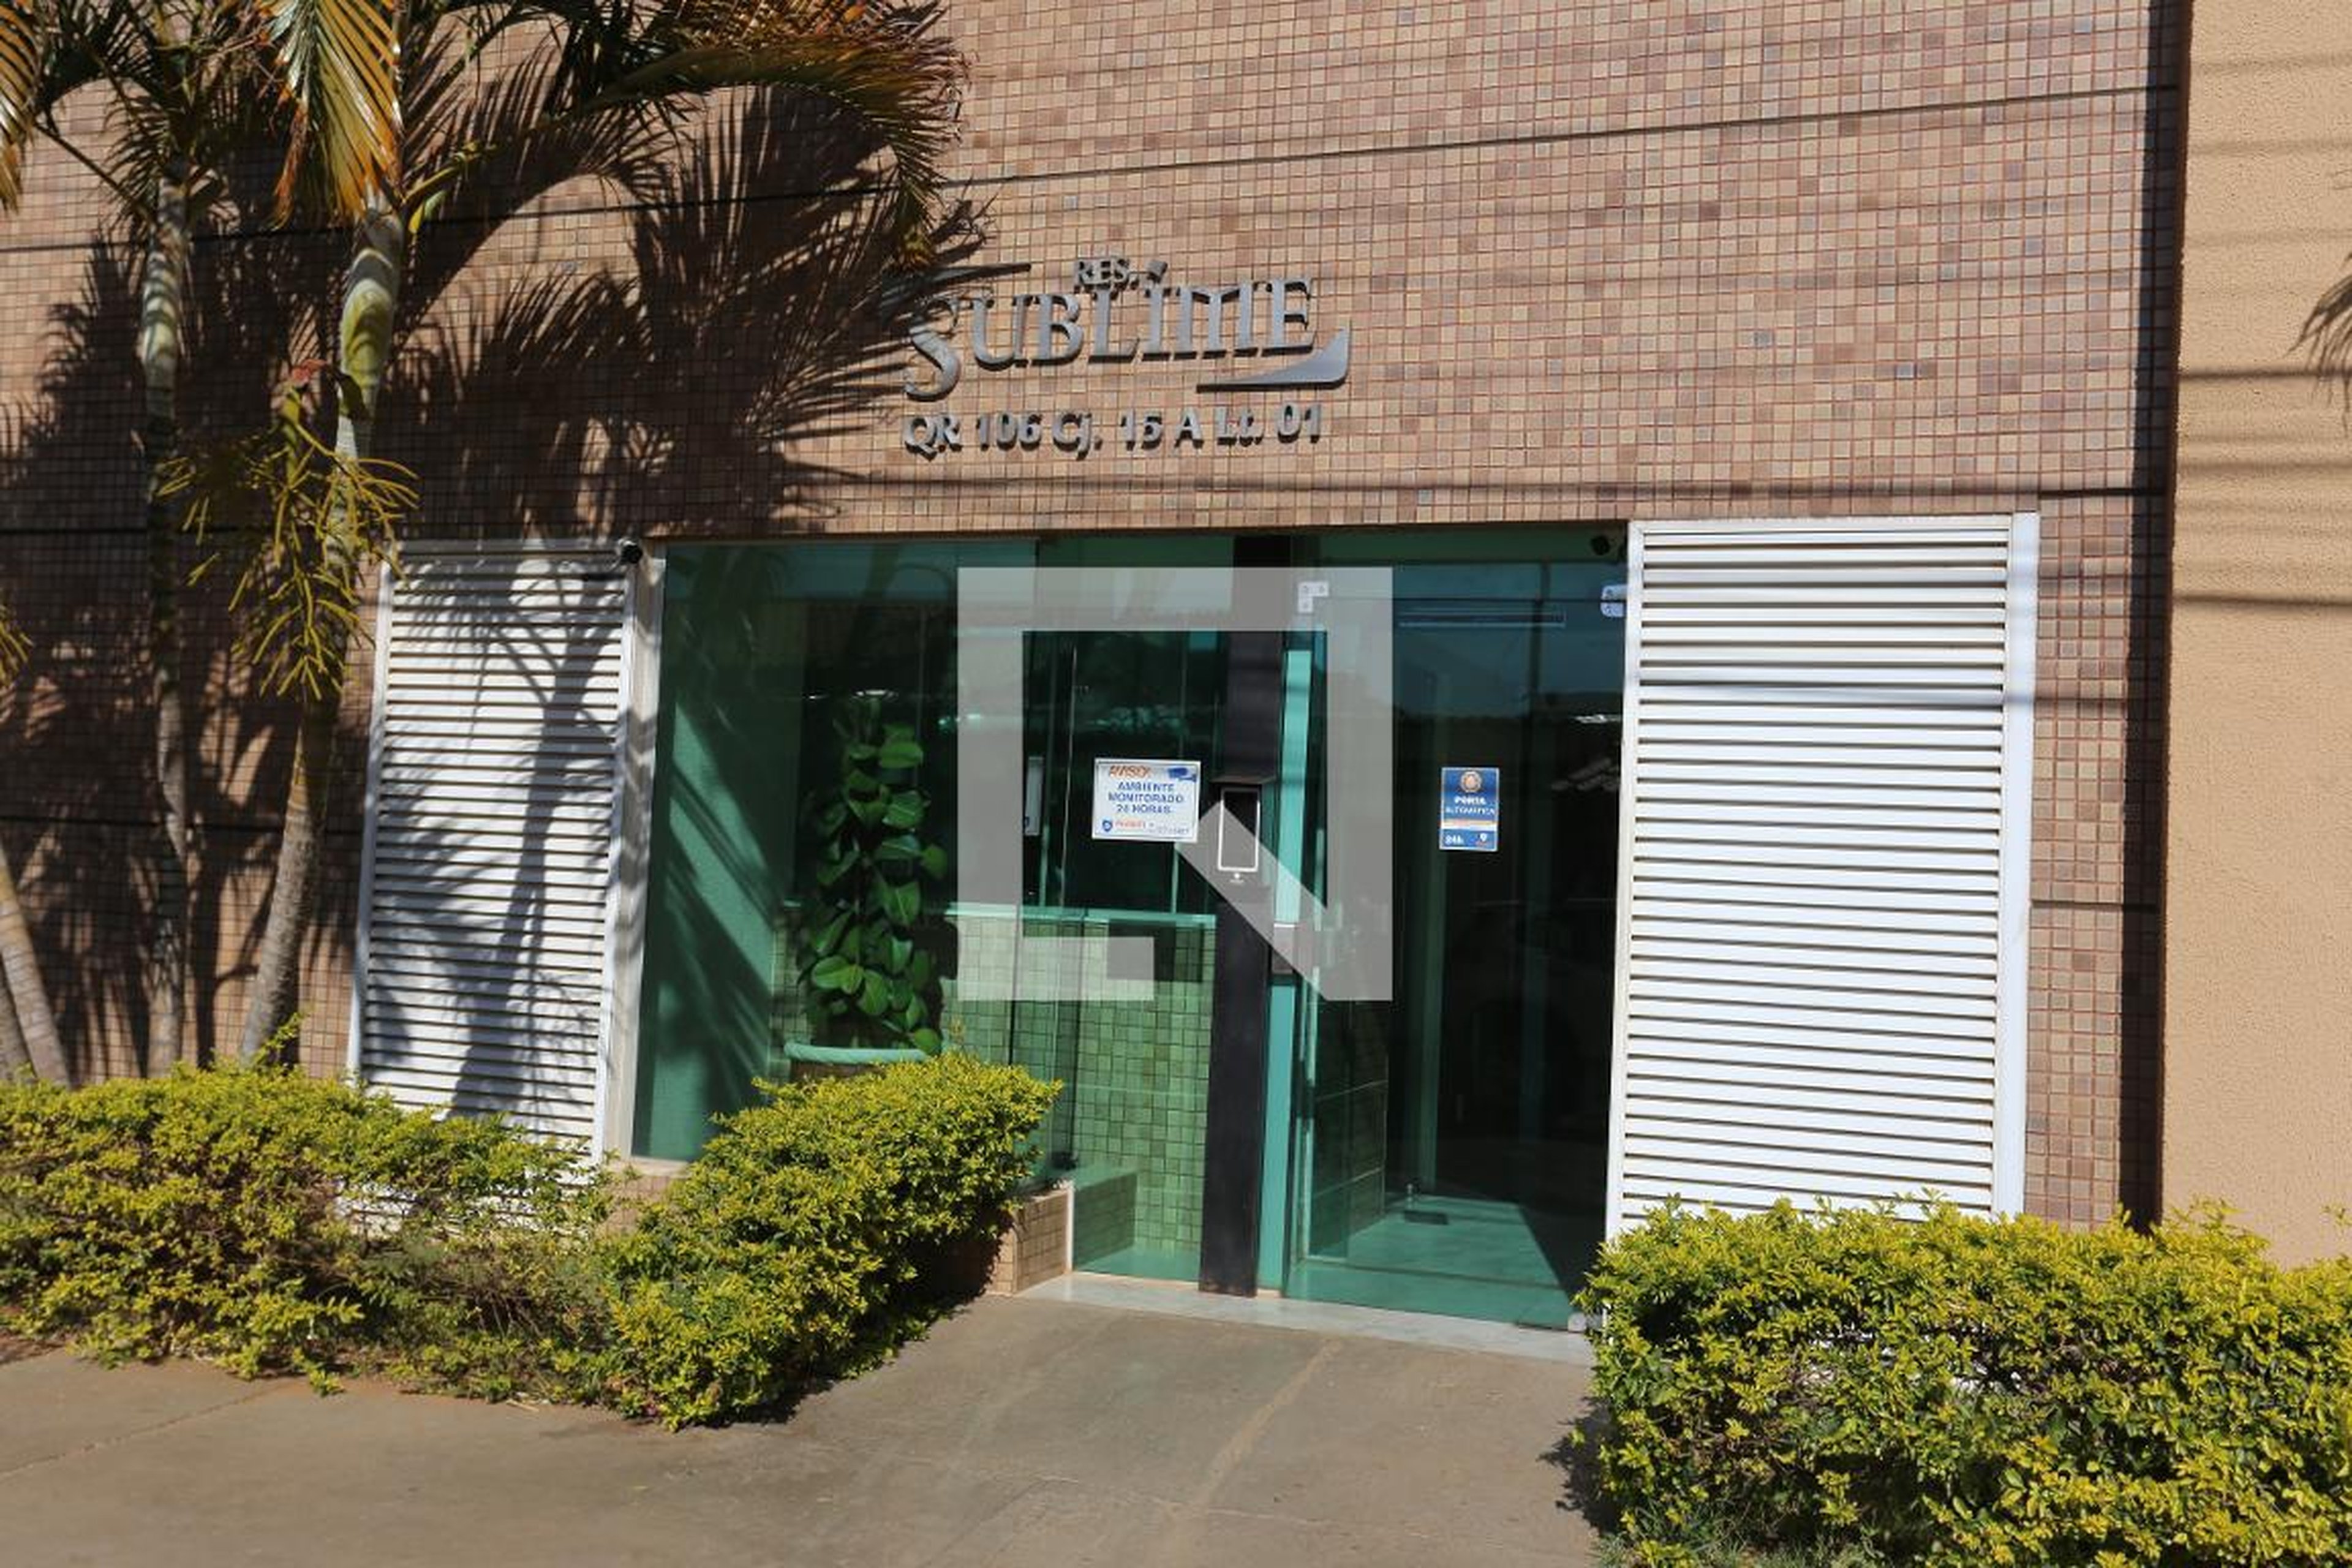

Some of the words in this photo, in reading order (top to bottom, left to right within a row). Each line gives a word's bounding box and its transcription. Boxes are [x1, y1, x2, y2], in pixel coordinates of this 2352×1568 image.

[903, 413, 963, 462] QR
[976, 410, 1042, 451] 106
[1120, 408, 1163, 451] 15
[1174, 407, 1204, 448] A
[1276, 401, 1322, 444] 01
[1117, 781, 1175, 792] AMBIENTE
[1108, 792, 1183, 803] MONITORADO
